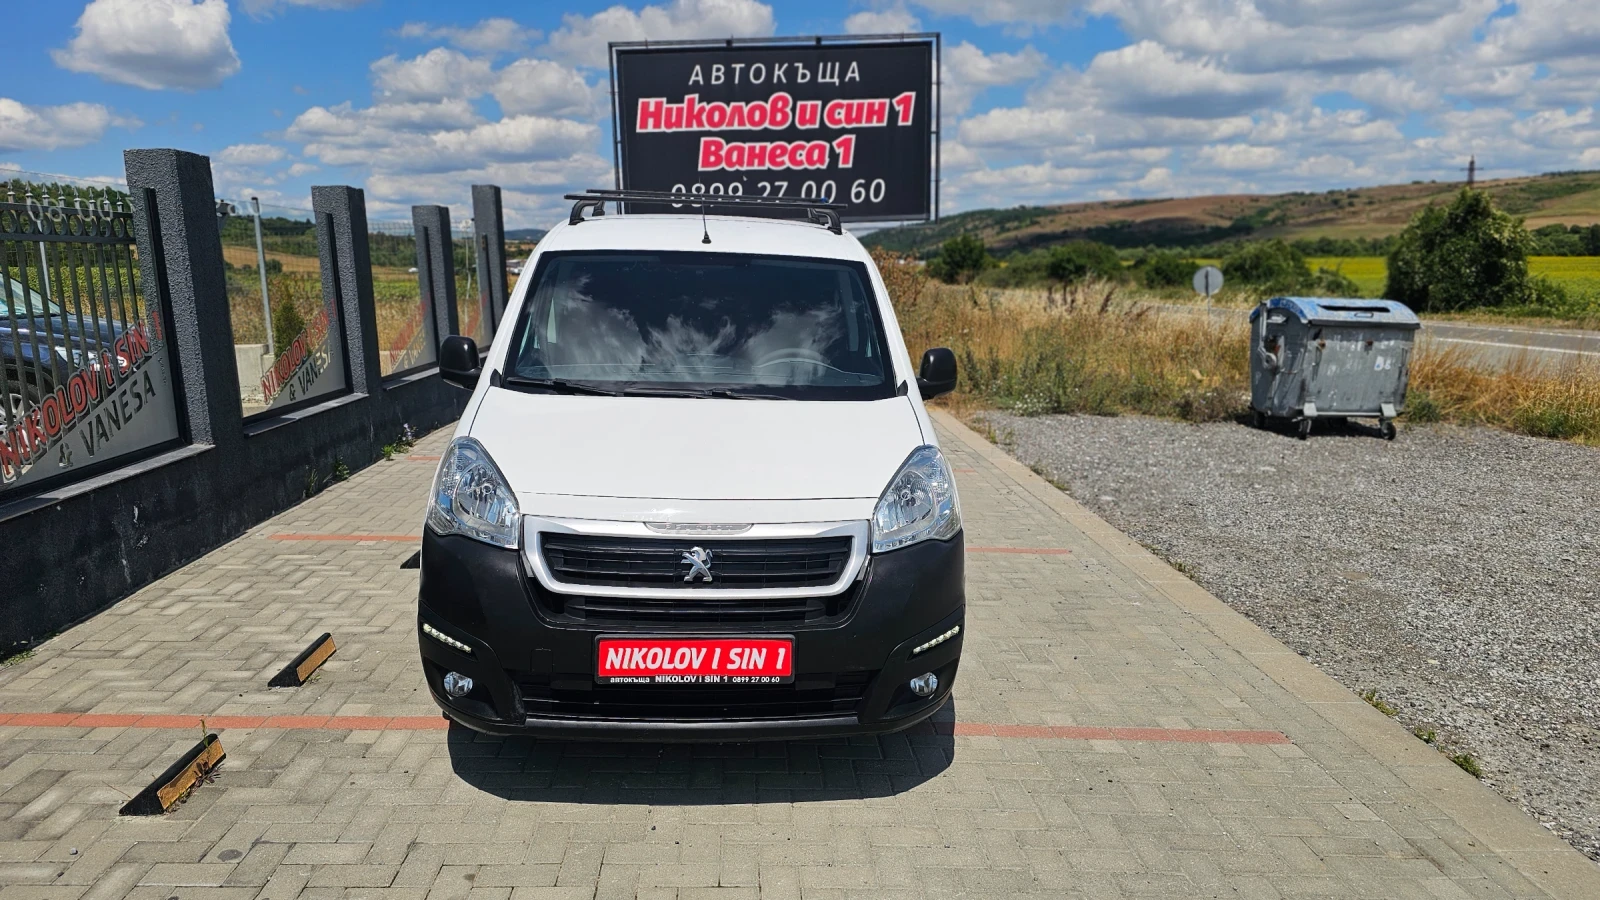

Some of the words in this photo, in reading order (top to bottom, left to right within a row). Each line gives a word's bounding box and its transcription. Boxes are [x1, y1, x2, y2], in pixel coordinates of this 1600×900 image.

[688, 61, 861, 86] АВТОКЪЩА
[636, 92, 793, 133] Николов
[795, 100, 822, 129] и
[824, 98, 890, 129] син
[893, 91, 917, 126] 1
[698, 136, 830, 172] Ванеса
[833, 134, 857, 168] 1
[671, 182, 743, 207] 0899
[757, 181, 789, 203] 27
[801, 180, 837, 204] 00
[850, 179, 886, 203] 60
[261, 330, 307, 404] NIKOLOV
[0, 361, 99, 480] NIKOLOV
[115, 318, 151, 376] SIN
[59, 442, 74, 469] &
[79, 369, 157, 458] VANESA
[605, 647, 707, 670] NIKOLOV
[712, 647, 721, 670] I
[727, 647, 767, 670] SIN
[775, 647, 786, 670] 1
[610, 676, 650, 684] автокъща
[655, 675, 698, 683] NIKOLOV
[704, 675, 721, 683] SIN
[723, 675, 728, 683] 1
